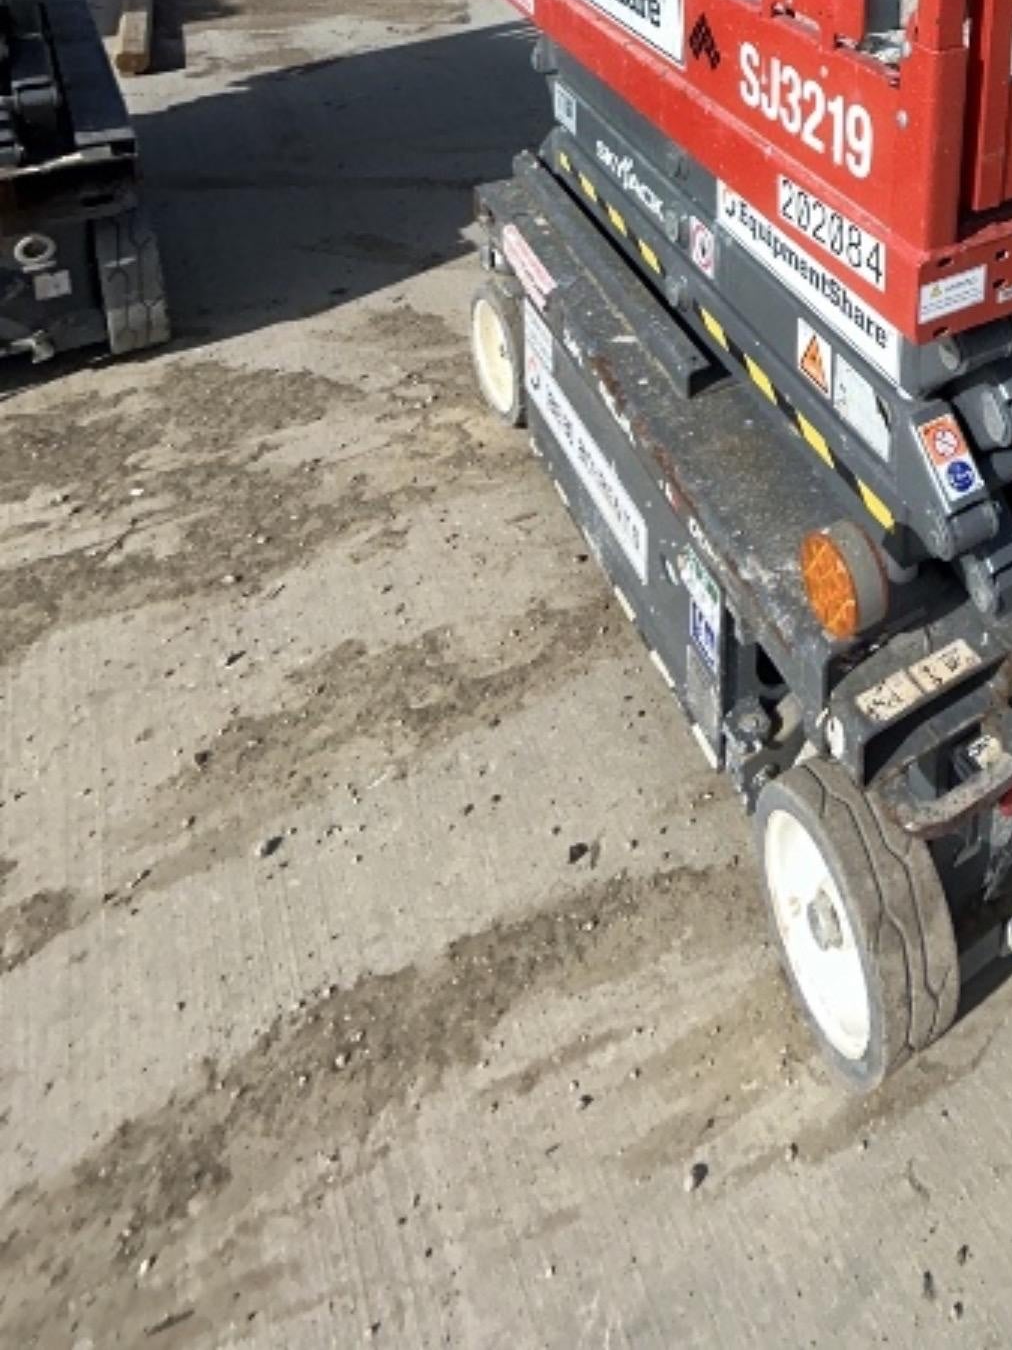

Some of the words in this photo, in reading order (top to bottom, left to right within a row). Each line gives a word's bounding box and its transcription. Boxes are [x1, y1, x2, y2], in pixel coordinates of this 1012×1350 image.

[739, 41, 873, 179] SJ3219
[738, 201, 888, 349] EquipmentShare
[780, 178, 885, 284] 202084
